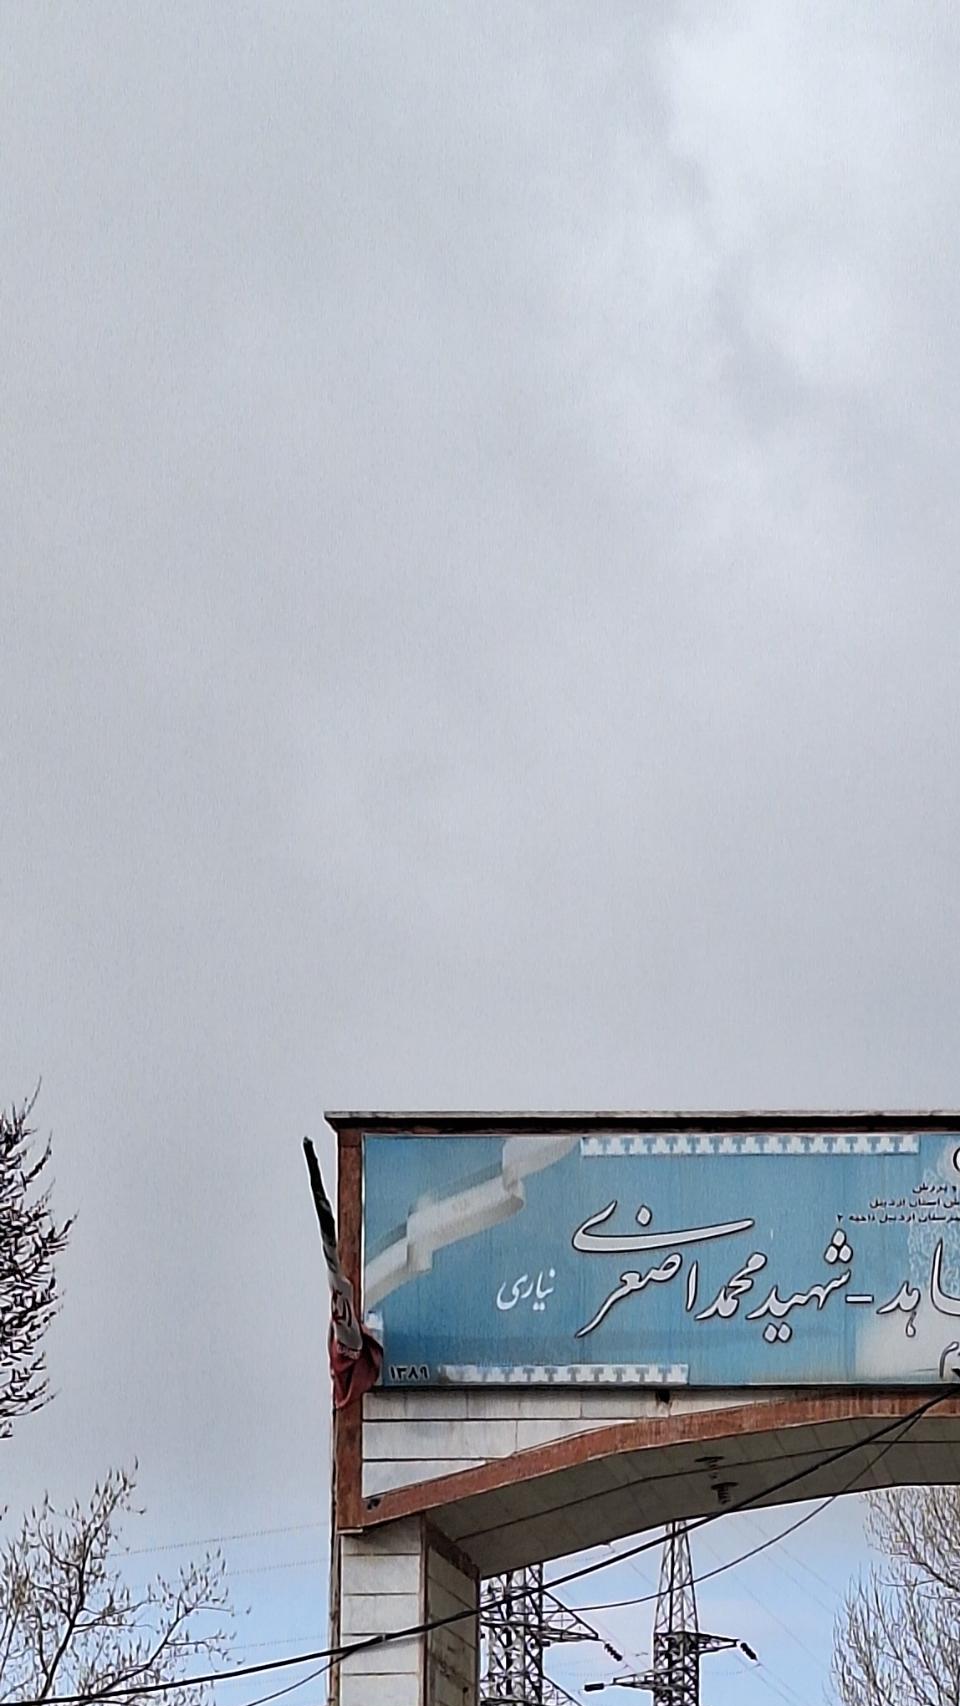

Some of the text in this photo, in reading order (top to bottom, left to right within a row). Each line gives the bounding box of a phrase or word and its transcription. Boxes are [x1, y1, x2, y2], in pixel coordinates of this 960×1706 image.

[496, 1270, 556, 1313] نیاری
[571, 1199, 756, 1340] اصغری
[697, 1251, 769, 1321] محمد
[747, 1229, 855, 1344] شهید
